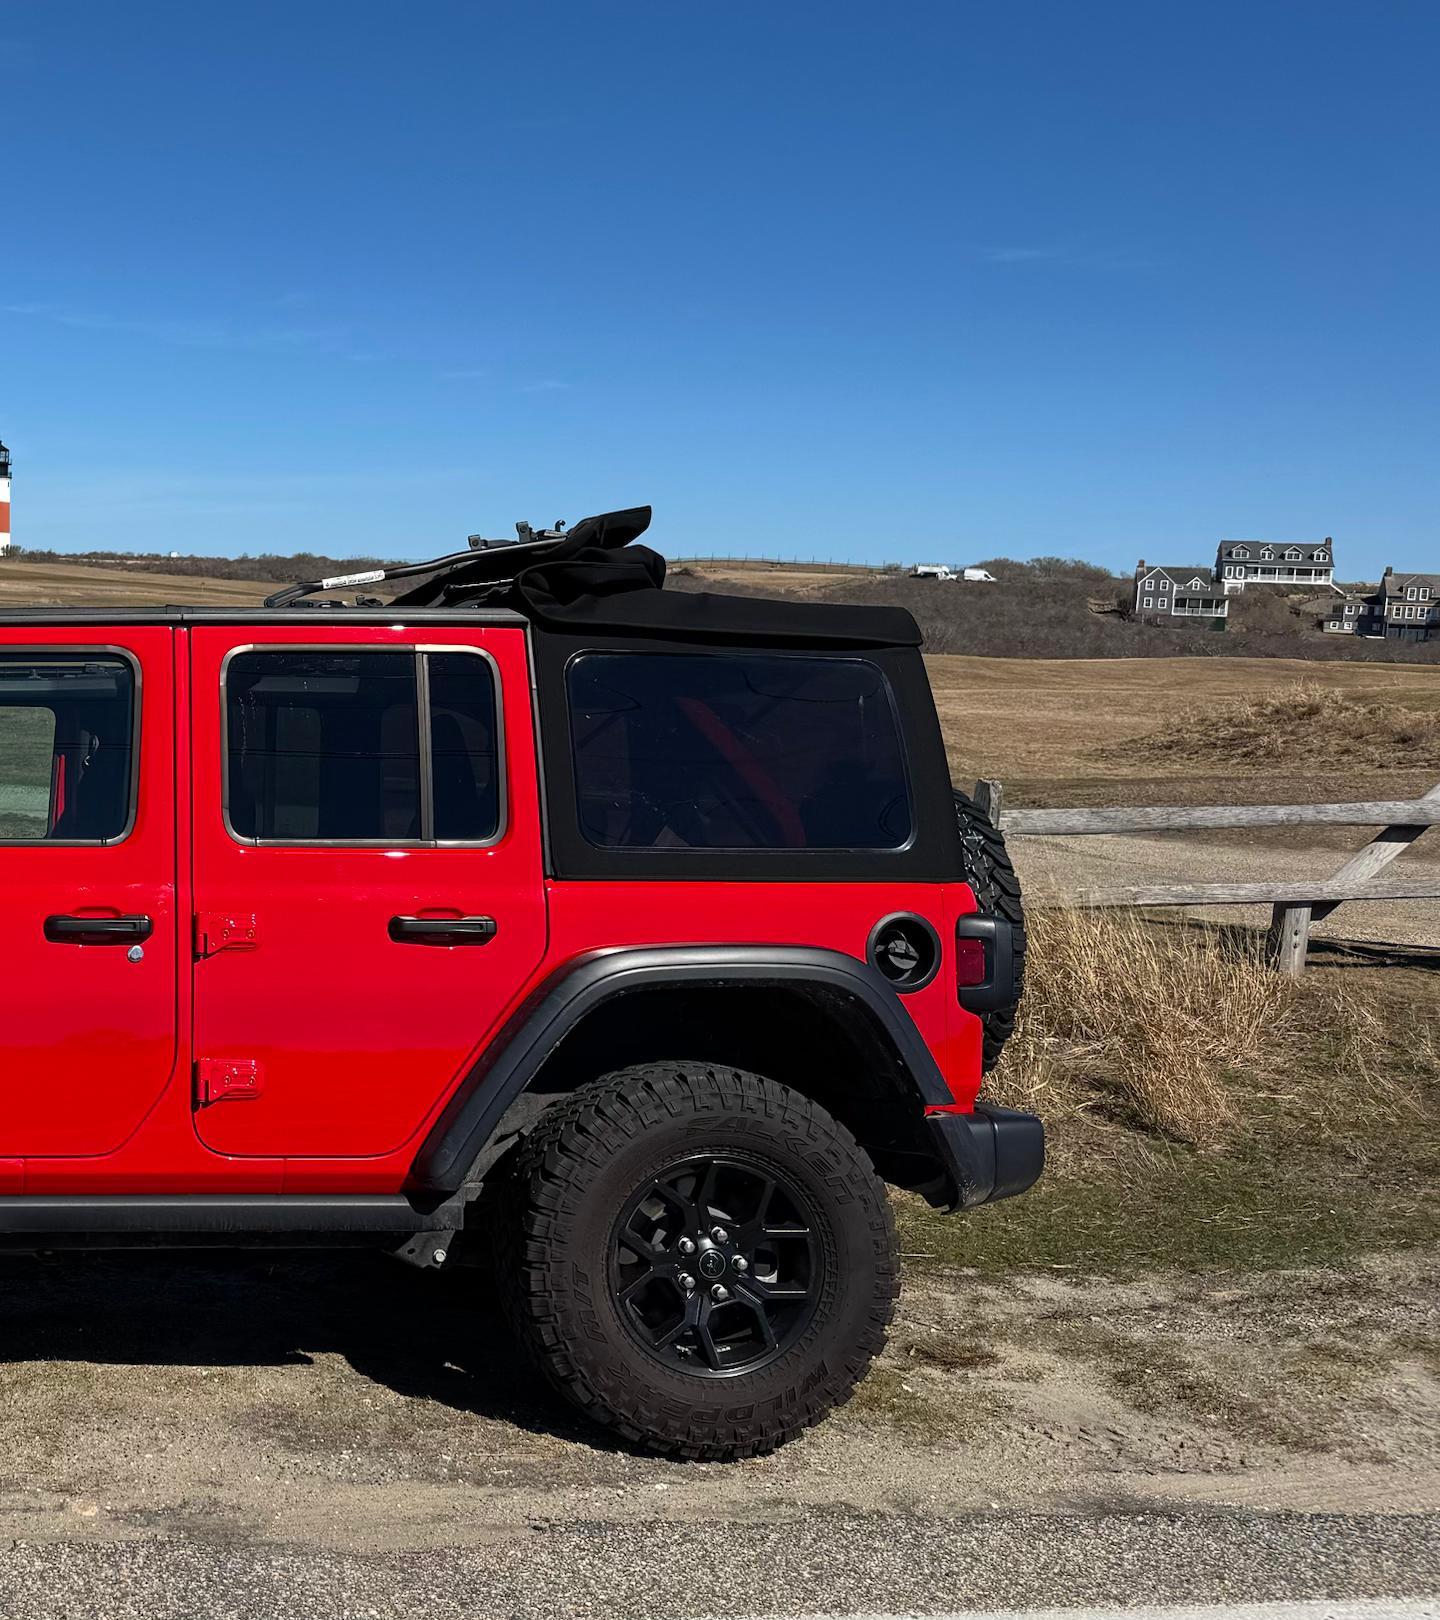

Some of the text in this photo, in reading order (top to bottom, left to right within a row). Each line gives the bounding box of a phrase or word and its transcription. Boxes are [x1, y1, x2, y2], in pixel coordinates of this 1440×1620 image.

[680, 1115, 855, 1205] FALKEN
[571, 1262, 829, 1424] WILDPEAK M/T
